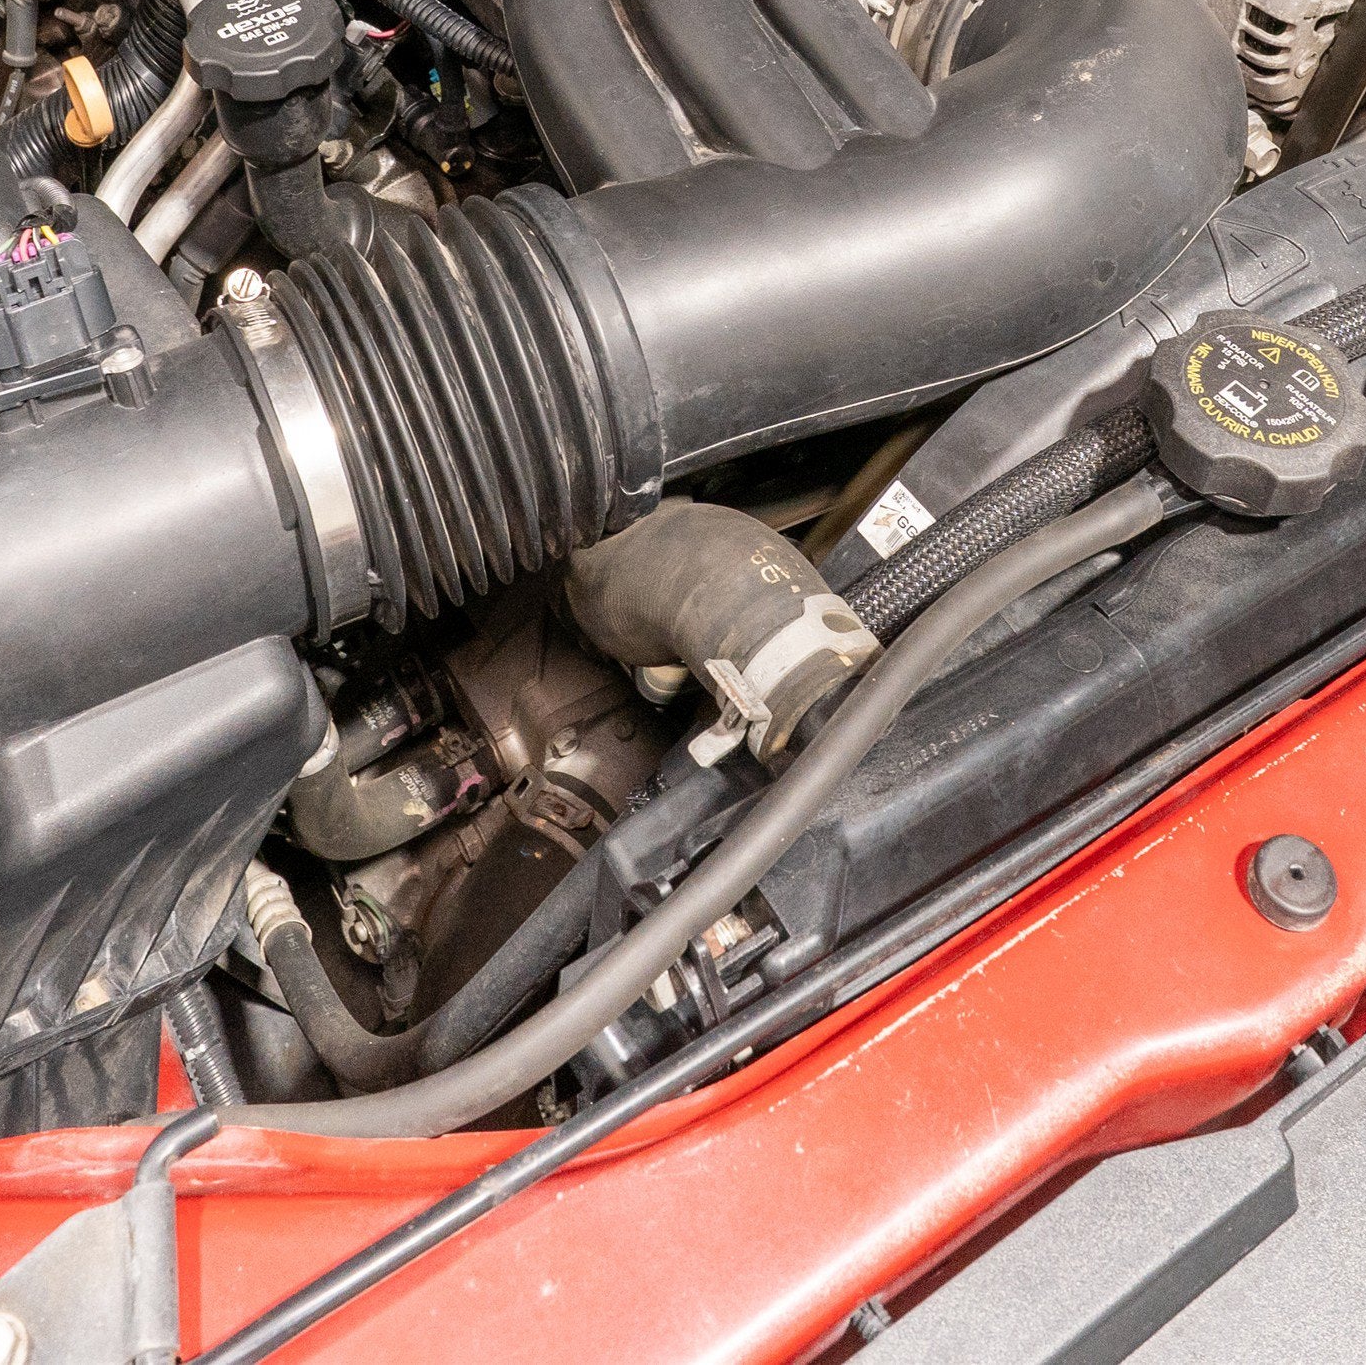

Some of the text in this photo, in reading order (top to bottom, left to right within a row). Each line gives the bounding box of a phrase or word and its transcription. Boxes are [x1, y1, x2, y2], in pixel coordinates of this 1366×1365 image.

[217, 0, 302, 39] dexos
[239, 16, 298, 42] SAE 5W-30
[1193, 342, 1214, 359] NE
[1216, 334, 1265, 371] RADIATOR
[1221, 347, 1233, 357] 15
[1231, 354, 1249, 368] PSI
[1251, 329, 1340, 398] NEVER OPEN HOT!
[1187, 356, 1205, 395] JAMAIS
[1198, 397, 1251, 439] OUVRIR
[1285, 384, 1337, 427] RADIATEUR
[1288, 397, 1305, 411] 105
[1268, 425, 1323, 446] CHAUD!
